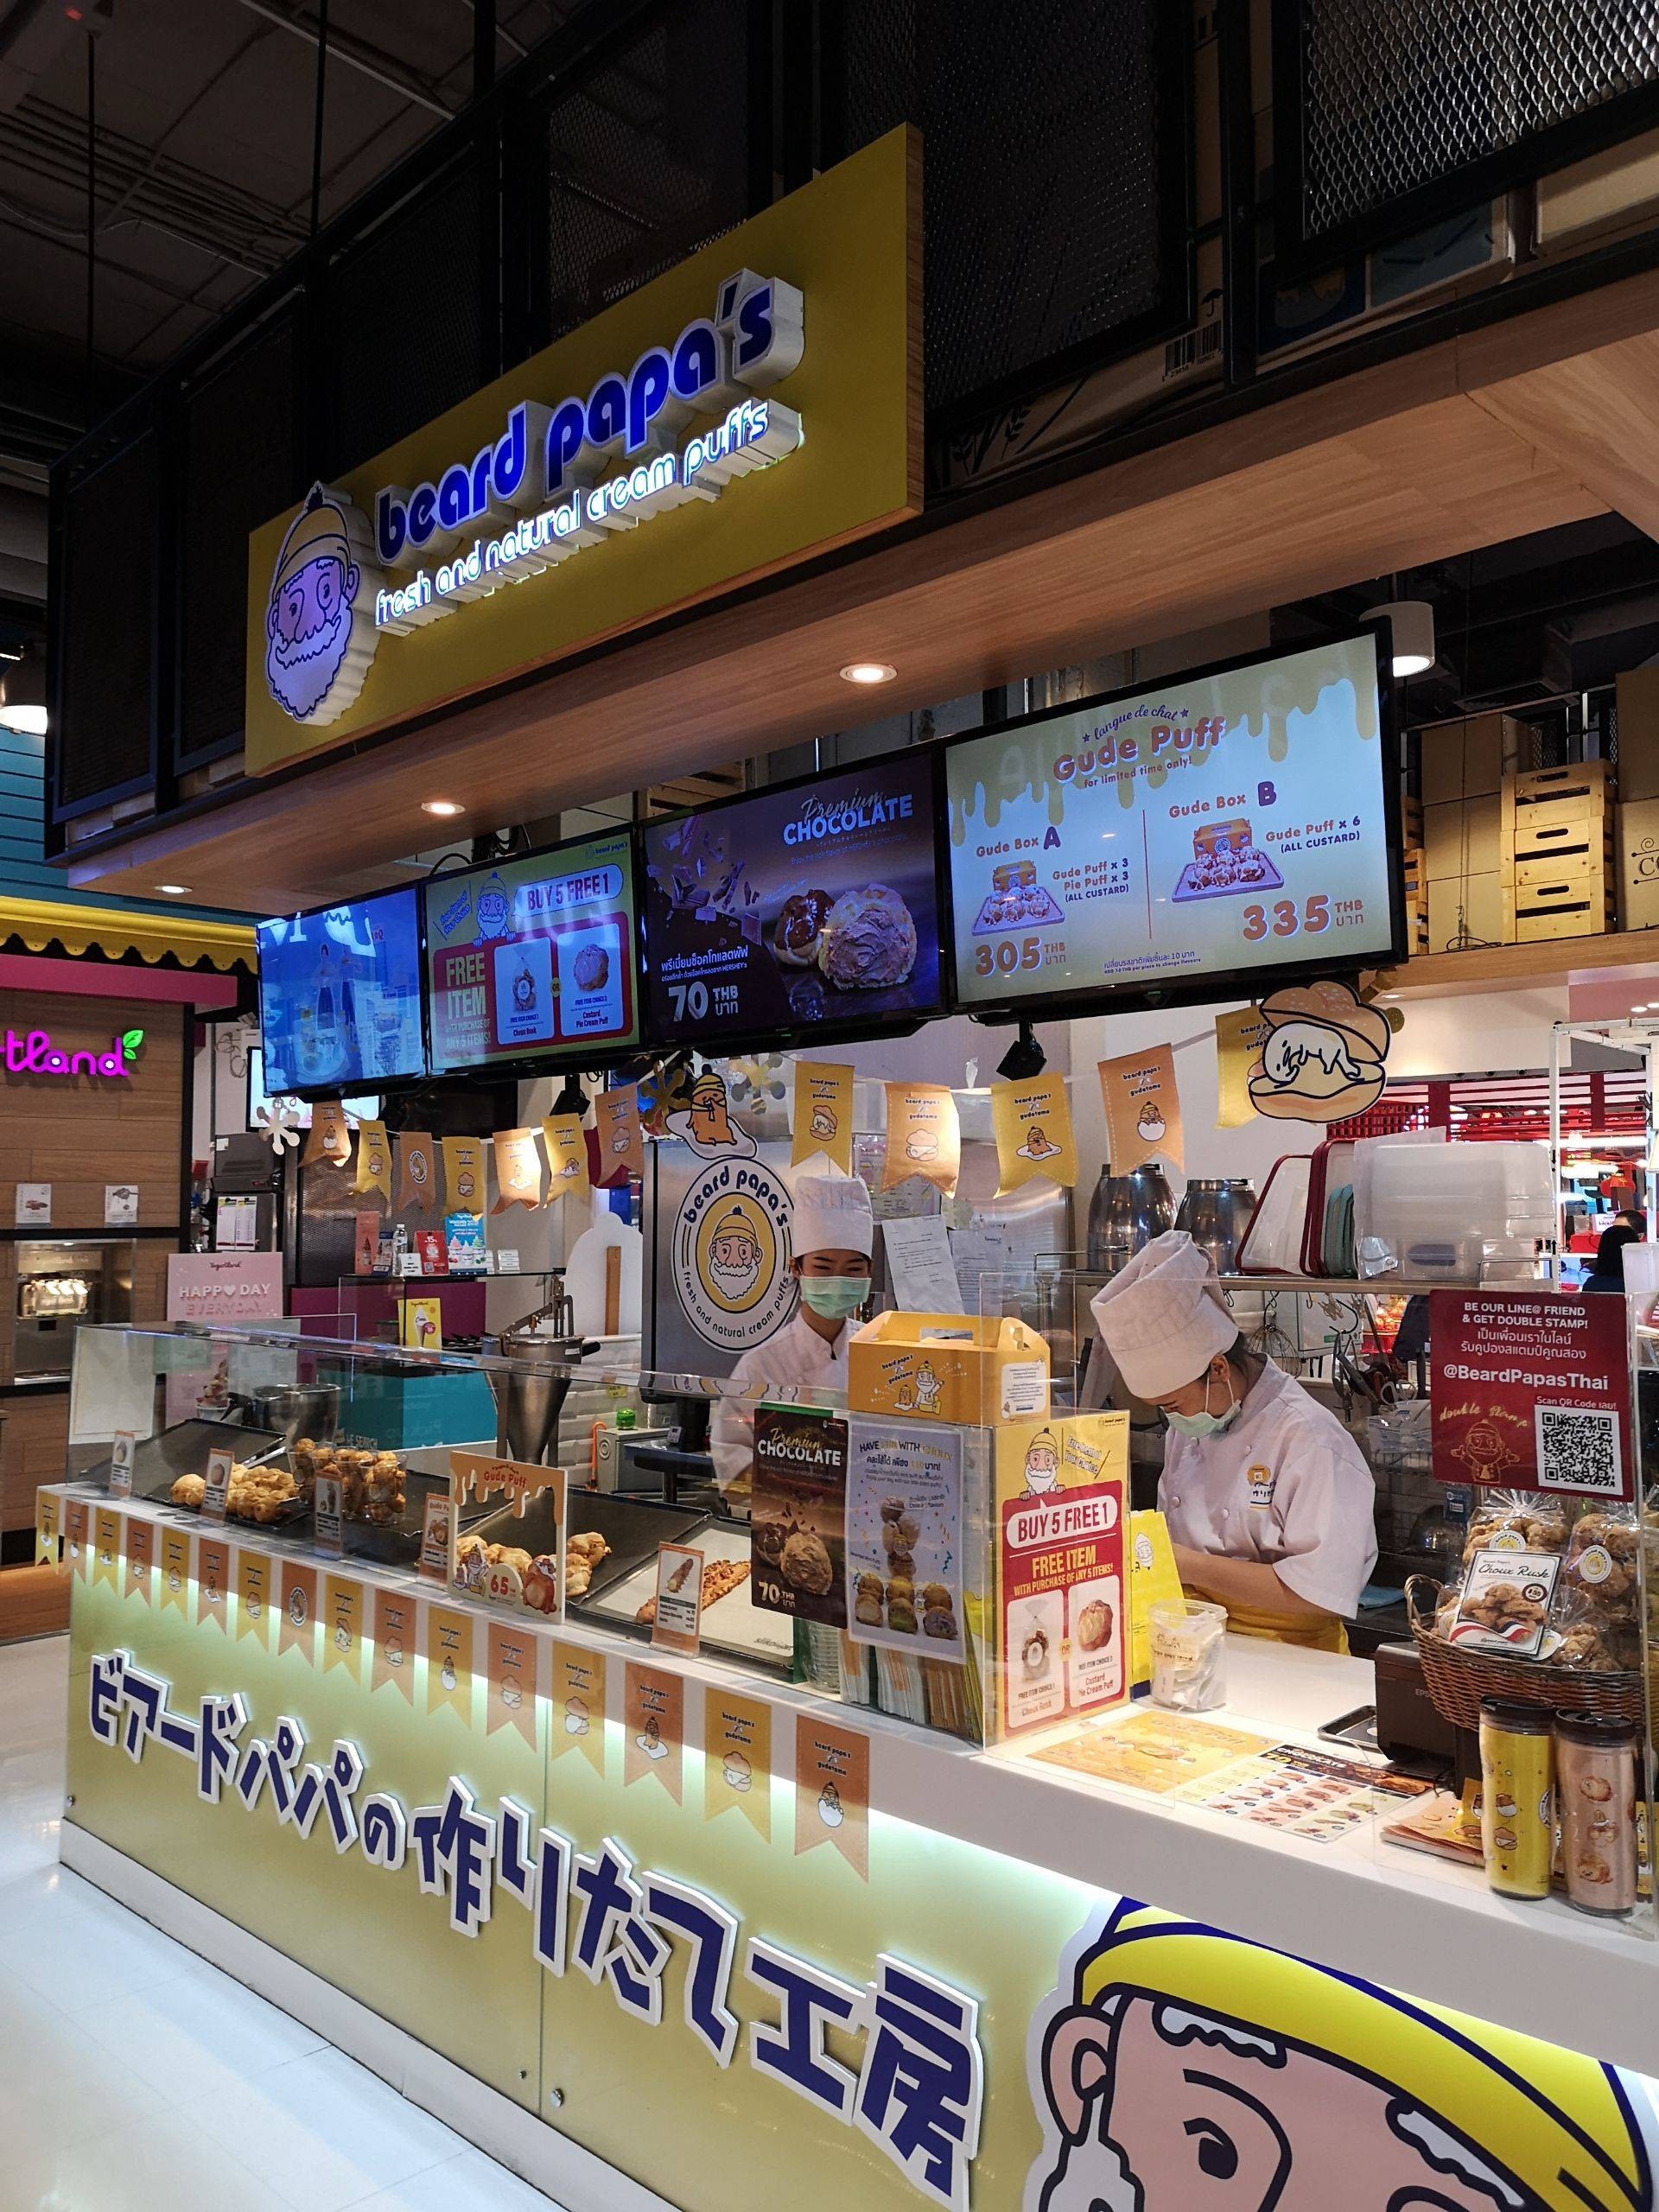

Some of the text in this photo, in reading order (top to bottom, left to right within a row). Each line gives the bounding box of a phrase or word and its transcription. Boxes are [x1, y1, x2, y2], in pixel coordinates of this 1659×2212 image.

[378, 286, 772, 560] beard papa's
[376, 399, 770, 626] fresh and natural cream puffs
[1094, 704, 1178, 741] langue de chat
[1053, 716, 1226, 782] Gude Puff
[1084, 755, 1192, 788] for limited time only!
[801, 787, 885, 821] Premium
[1169, 780, 1277, 818] Gude Box B
[784, 794, 913, 845] CHOCOLATE
[1266, 828, 1300, 842] Gude
[1306, 819, 1334, 835] Puff
[1352, 815, 1361, 826] 6
[976, 826, 1061, 857] Gude Box A
[1281, 830, 1361, 854] (ALL CUSTARD)
[1052, 868, 1080, 880] Gude
[1084, 861, 1108, 872] Puff
[1122, 857, 1128, 868] 3
[527, 873, 609, 911] BUY 5 FREE 1
[1064, 880, 1080, 891] Pie
[1084, 874, 1108, 885] Puff
[1122, 871, 1128, 880] 3
[1065, 883, 1129, 903] (ALL CUSTARD)
[1243, 894, 1363, 940] 335 THB
[1336, 914, 1363, 927] บาท
[976, 937, 1065, 976] 305 THB
[1045, 954, 1066, 965] บาท
[445, 952, 486, 988] FREE
[447, 985, 486, 1020] ITEM
[668, 981, 738, 1022] 70 THB
[715, 1001, 739, 1016] บาท
[1240, 1023, 1261, 1034] beard
[0, 1030, 130, 1077] tland
[1123, 1071, 1141, 1080] beard
[1130, 1084, 1161, 1096] gudetama
[1020, 1109, 1050, 1120] gudetama
[683, 1165, 788, 1227] beard papa's
[240, 1282, 271, 1296] DAY
[683, 1271, 789, 1338] fresh and natural cream puffs
[1464, 1302, 1586, 1316] BE OUR LINE@ FRIEND
[1462, 1314, 1588, 1329] & GET DOUBLE STAMP!
[1478, 1326, 1572, 1345] เป็นเพื่อนเราในไลน์
[1461, 1341, 1586, 1361] รับคูปองสแตมป์คูณสอง
[1444, 1363, 1609, 1391] @BeardPapasThai
[1439, 1402, 1481, 1422] double
[1536, 1395, 1597, 1409] Scan QR Code
[770, 1426, 820, 1450] Premium
[860, 1440, 880, 1452] HAVE
[899, 1441, 920, 1452] WITH
[758, 1440, 842, 1466] CHOCOLATE
[484, 1471, 526, 1488] Gude Puff
[1018, 1502, 1108, 1542] BUY 5 FREE 1
[1032, 1544, 1096, 1580] FREE ITEM
[1478, 1563, 1550, 1579] Choux Rusk
[490, 1574, 509, 1595] 65
[1014, 1583, 1032, 1597] WITH
[1032, 1574, 1066, 1592] PURCHASE
[1066, 1572, 1075, 1584] OF
[1075, 1568, 1087, 1581] ANY
[1092, 1563, 1114, 1577] ITEMS!
[759, 1581, 780, 1604] 70
[1096, 1656, 1109, 1666] CHOICE
[1085, 1673, 1105, 1687] Custard
[1086, 1680, 1114, 1695] Cream Puff
[1018, 1691, 1028, 1700] FREE
[721, 1712, 737, 1722] beard
[725, 1732, 752, 1744] gudetama
[815, 1740, 831, 1752] beard
[817, 1761, 847, 1777] gudetama
[92, 1654, 969, 2201] ビアードパパの作りたて工房
